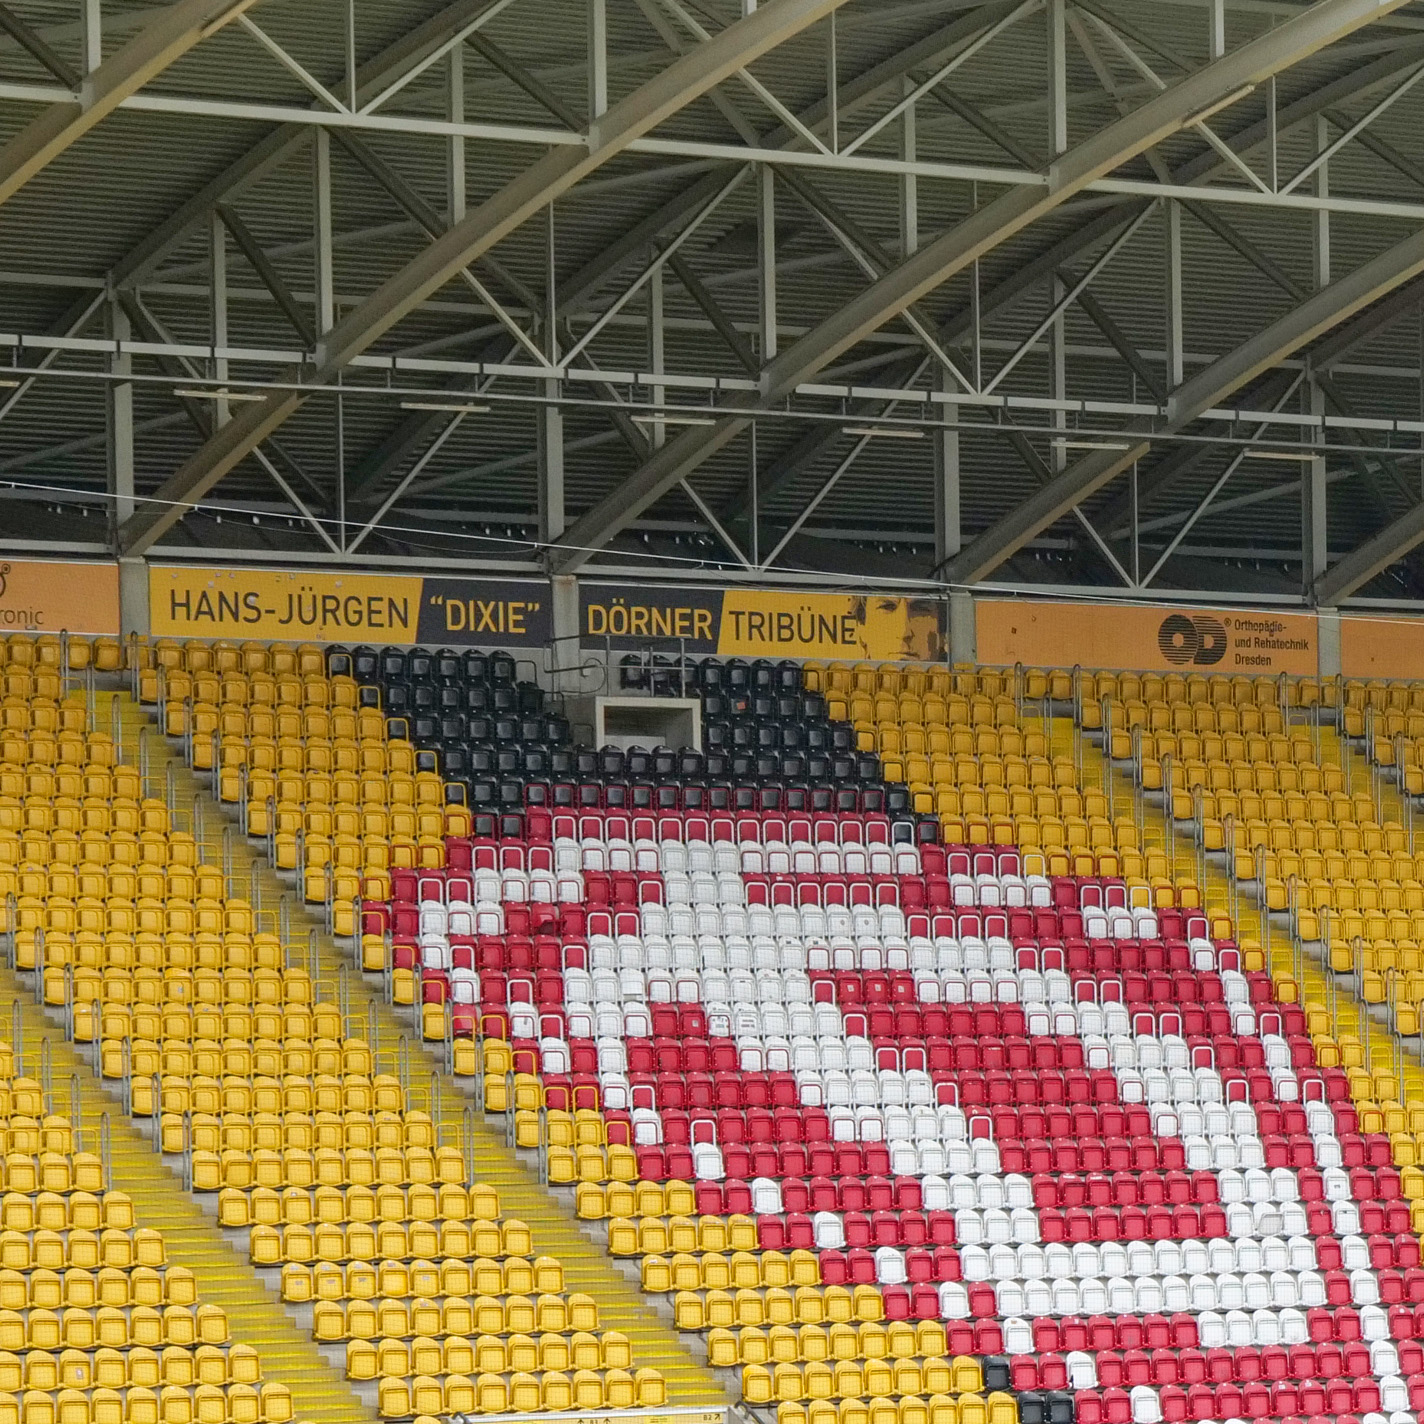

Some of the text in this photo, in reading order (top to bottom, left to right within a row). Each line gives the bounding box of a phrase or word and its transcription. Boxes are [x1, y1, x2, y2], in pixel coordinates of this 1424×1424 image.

[170, 586, 409, 628] HANS-JÜRGEN
[587, 597, 858, 645] DÖRNER TRIBÜNE
[1235, 619, 1287, 634] Orthopädie-
[1235, 637, 1309, 650] und Rehatechnik
[1235, 653, 1272, 666] Dresden
